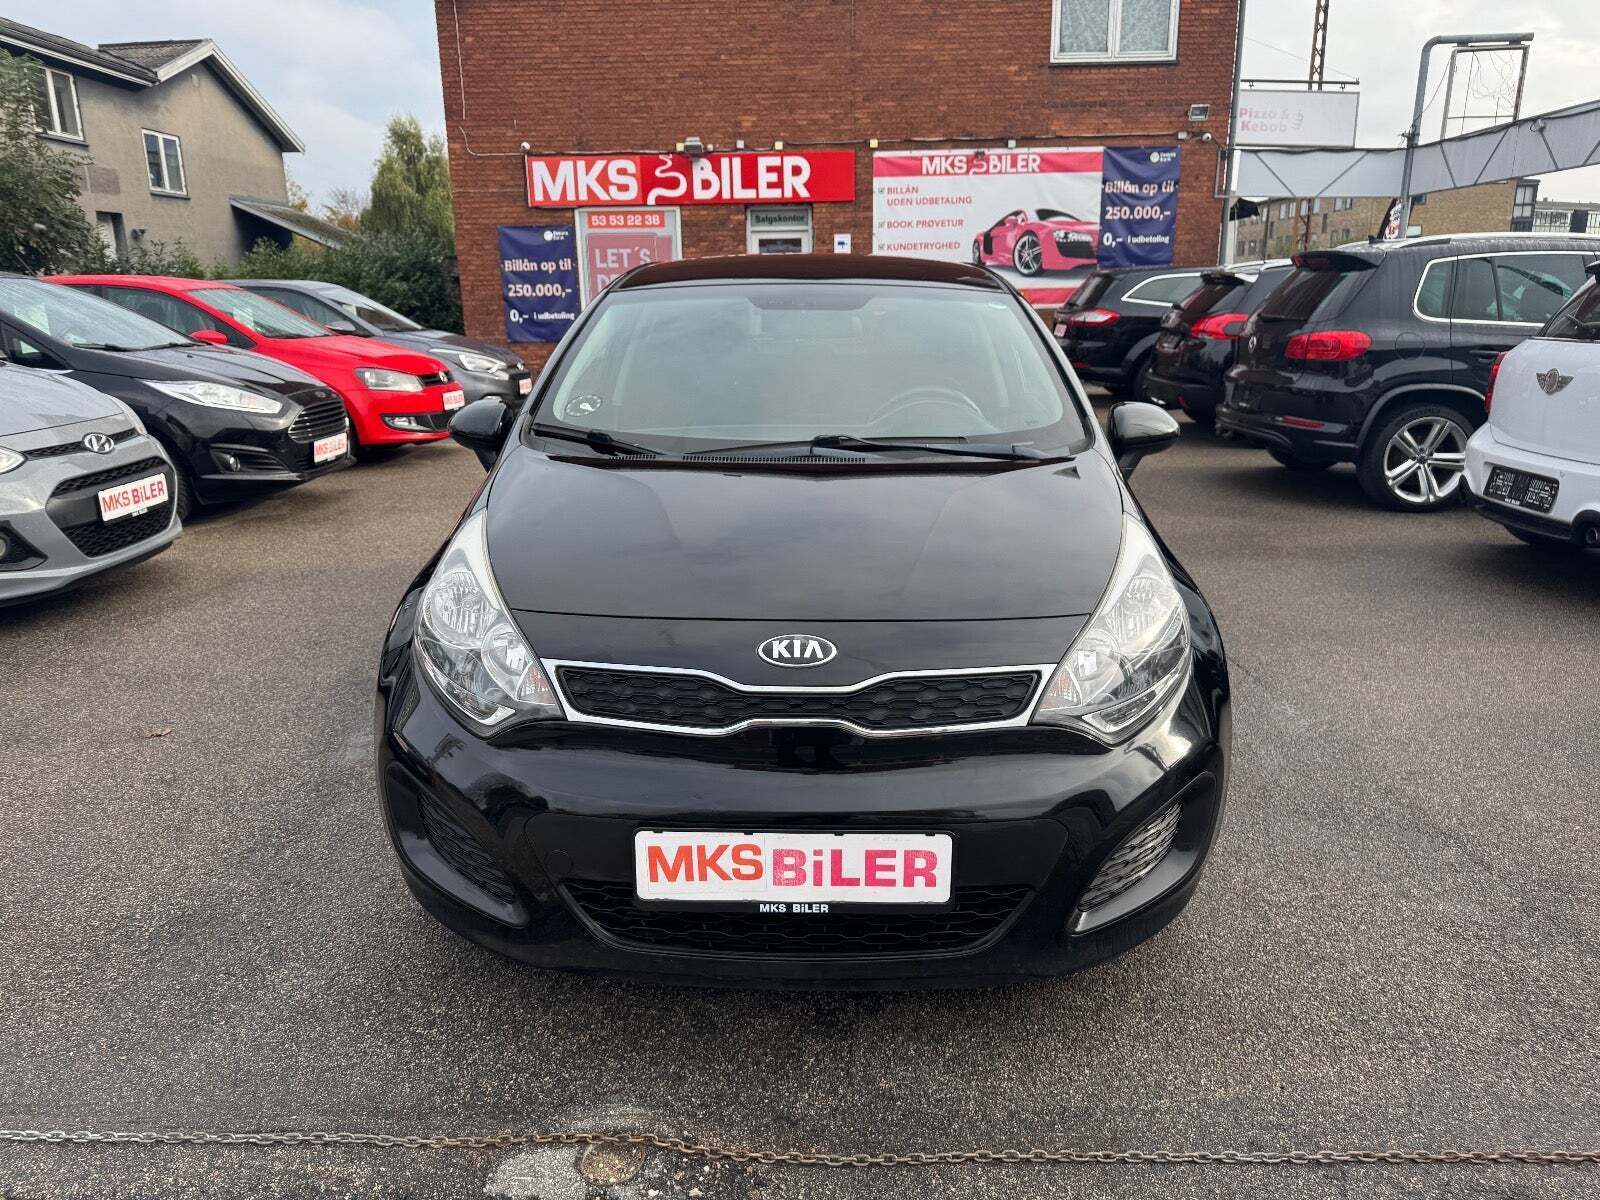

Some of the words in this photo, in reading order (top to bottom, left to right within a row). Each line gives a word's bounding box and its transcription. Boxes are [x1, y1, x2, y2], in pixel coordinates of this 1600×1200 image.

[921, 155, 967, 175] MKS
[531, 159, 638, 202] MKS
[692, 155, 812, 200] BILER
[1142, 184, 1158, 196] op
[1161, 181, 1174, 193] til
[915, 196, 972, 206] UDBETALING
[591, 215, 607, 226] 53
[609, 215, 625, 226] 53
[626, 214, 643, 226] 22
[755, 214, 805, 224] Salgskontor
[1104, 206, 1171, 221] 250.000,-
[886, 242, 960, 250] KUNDETRYGHED
[504, 259, 538, 272] Billån
[540, 261, 556, 274] op
[558, 258, 572, 271] til
[508, 284, 572, 298] 250.000,-
[102, 490, 131, 512] MKS
[131, 481, 165, 505] BiLER
[647, 843, 764, 883] MKS
[772, 848, 938, 888] BiLER
[759, 904, 787, 913] MKS
[792, 903, 829, 914] BiLER
